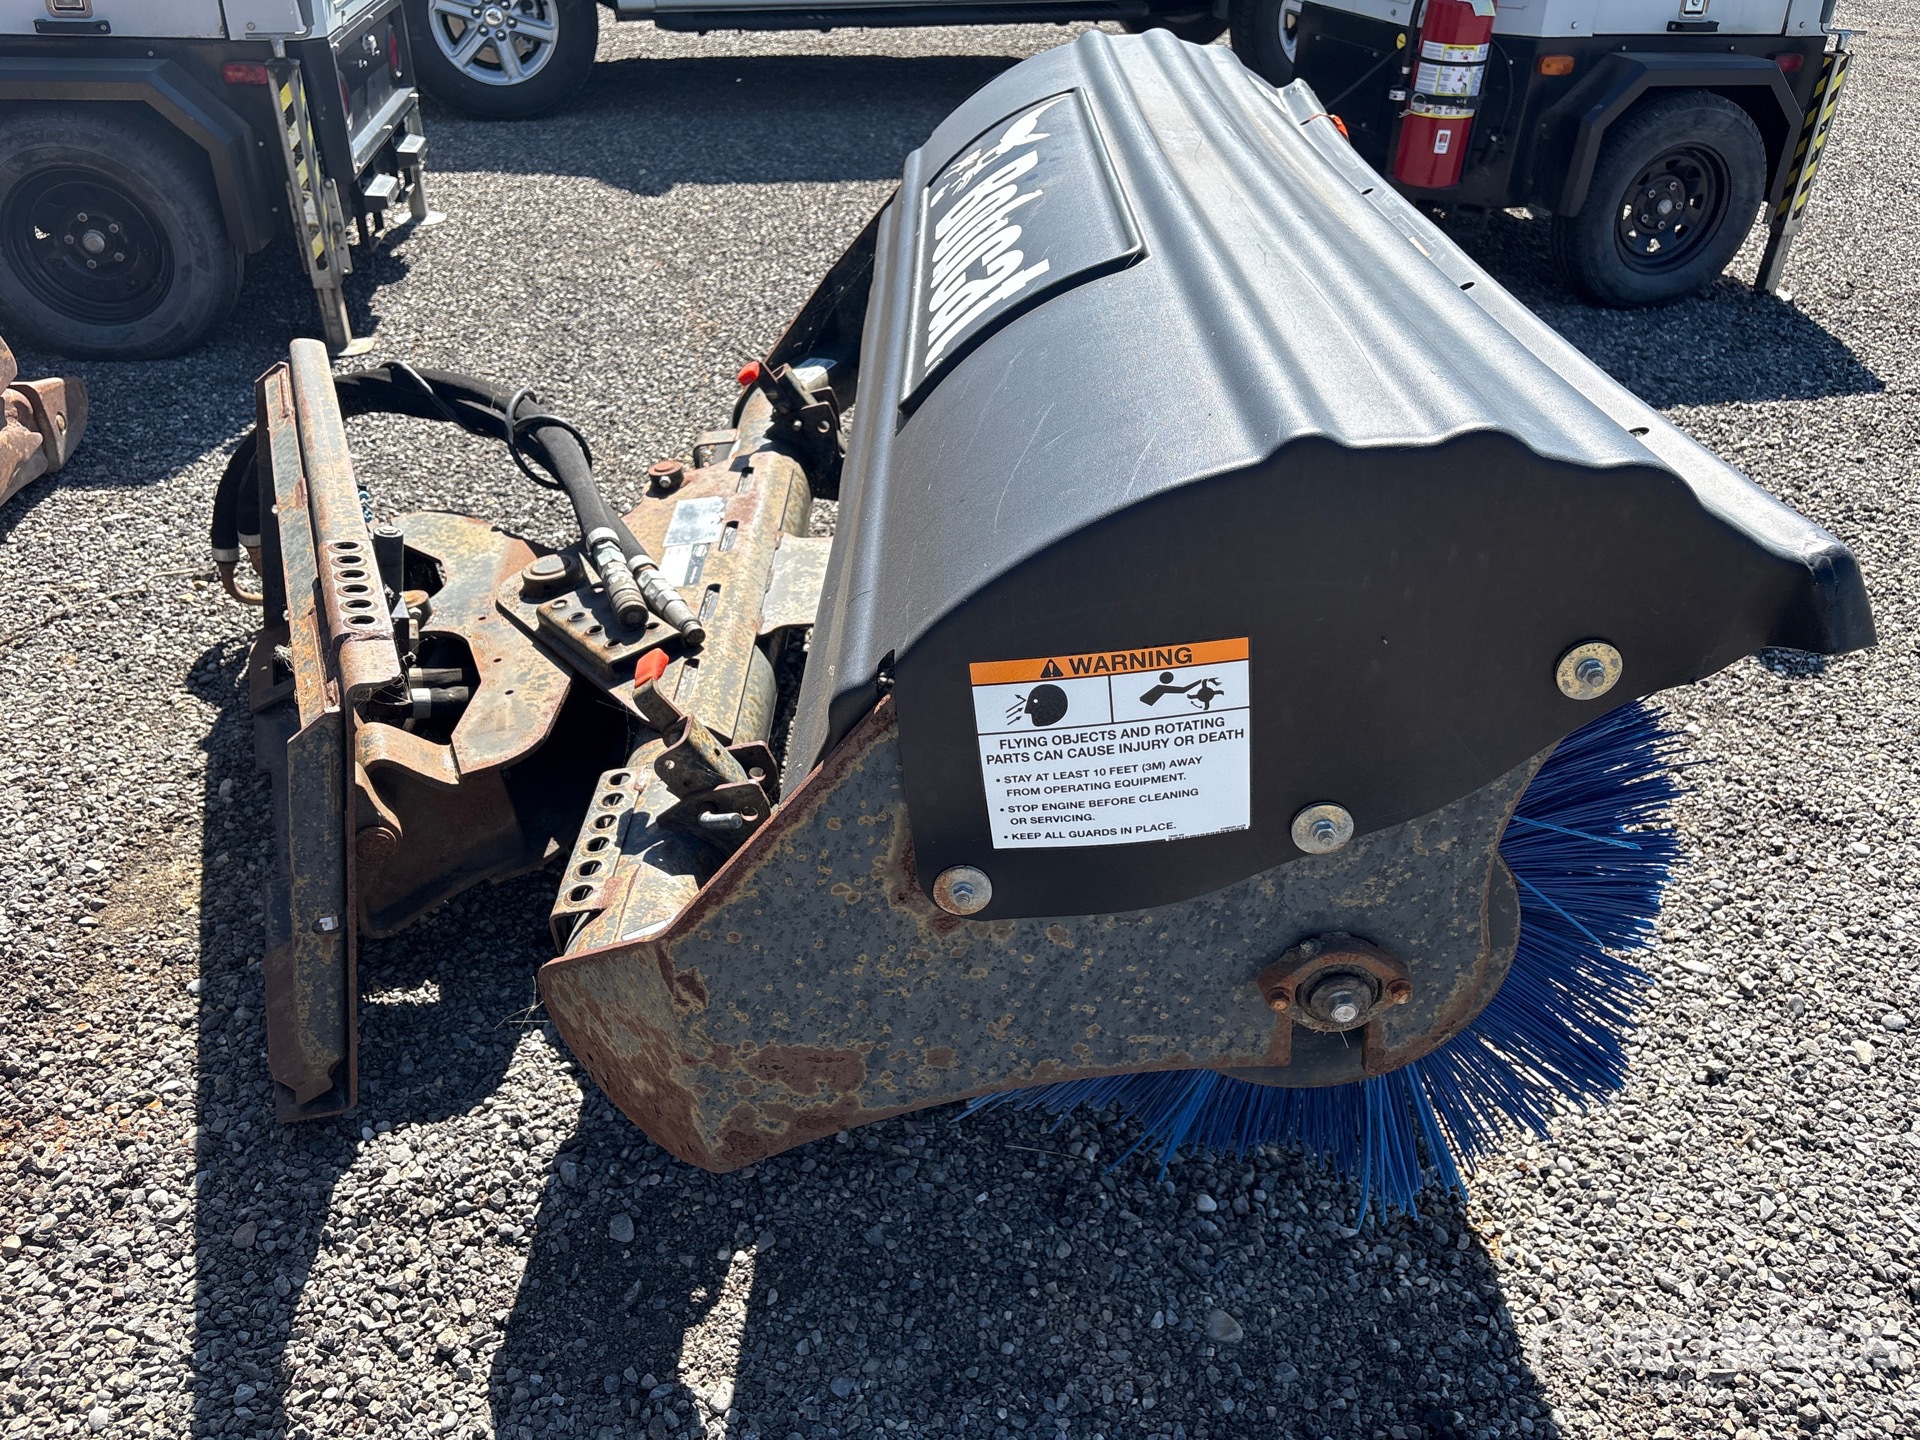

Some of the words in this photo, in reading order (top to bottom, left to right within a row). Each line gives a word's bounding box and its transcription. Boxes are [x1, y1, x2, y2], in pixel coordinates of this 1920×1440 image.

[925, 149, 1051, 367] Bobcat
[1068, 646, 1193, 675] WARNING
[986, 751, 1030, 765] PARTS
[1033, 749, 1064, 762] CAN
[1067, 744, 1115, 759] CAUSE
[1119, 738, 1170, 754] INJURY
[1173, 734, 1195, 747] OR
[1198, 728, 1244, 745] DEATH
[1000, 736, 1048, 750] FLYING
[1051, 729, 1117, 746] OBJECTS
[1120, 725, 1151, 740] AND
[1155, 716, 1225, 736] ROTATING
[1003, 773, 1033, 784] STAY
[1035, 772, 1050, 782] AT
[1053, 769, 1090, 781] LEAST
[1093, 767, 1107, 777] 10
[1109, 764, 1139, 776] FEET
[1141, 760, 1166, 773] (3M)
[1168, 755, 1203, 769] AWAY
[1006, 787, 1041, 797] FROM
[1043, 781, 1111, 795] OPERATING
[1114, 772, 1187, 789] EQUIPMENT.
[1007, 804, 1039, 813] STOP
[1041, 800, 1086, 811] ENGINE
[1088, 795, 1136, 808] BEFORE
[1138, 788, 1199, 803] CLEANING
[1010, 817, 1028, 825] OR
[1030, 813, 1096, 824] SERVICING.
[1011, 832, 1042, 841] KEEP
[1044, 831, 1066, 840] ALL
[1068, 827, 1118, 839] GUARDS
[1120, 826, 1132, 835] IN
[1135, 821, 1177, 834] PLACE.
